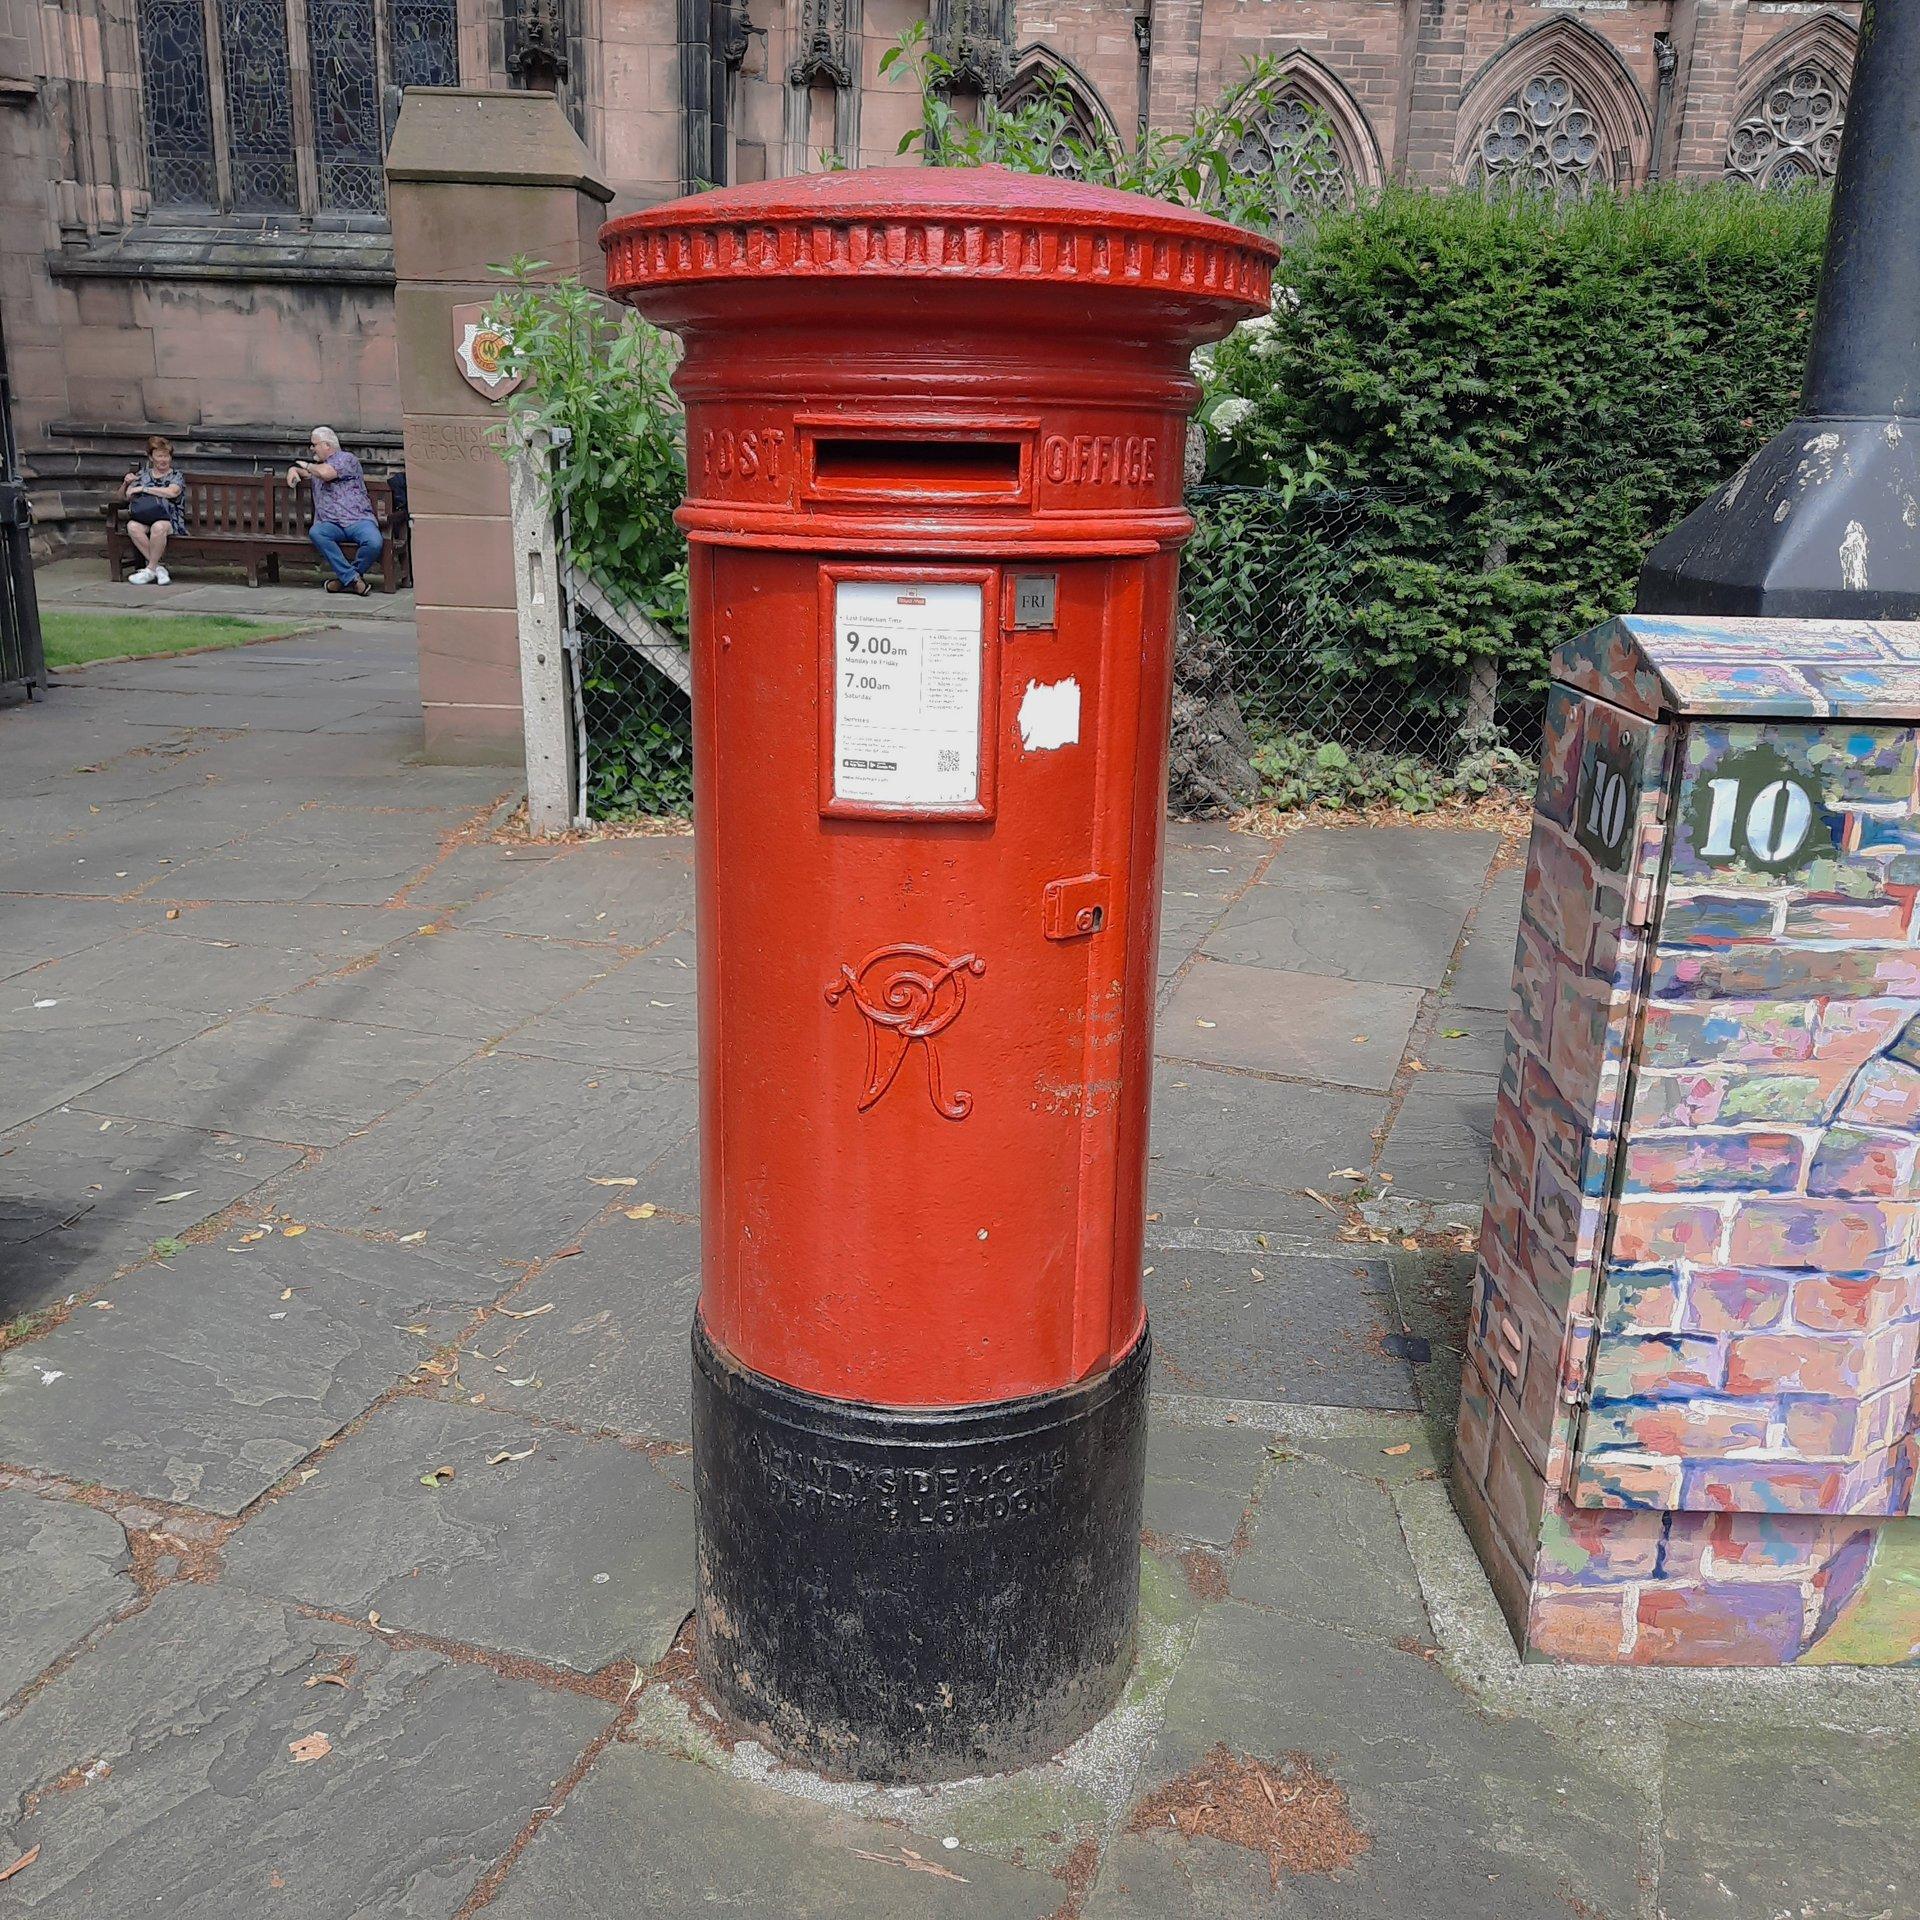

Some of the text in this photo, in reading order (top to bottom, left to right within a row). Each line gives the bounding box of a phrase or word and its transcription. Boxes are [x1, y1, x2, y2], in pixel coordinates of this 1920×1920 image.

[410, 424, 437, 441] THE
[703, 426, 1157, 487] POST OFFICE
[1021, 594, 1046, 608] FRI
[847, 631, 908, 655] 9.00am
[845, 672, 891, 690] 7.00am
[1586, 760, 1628, 849] 10
[1699, 777, 1813, 863] 10
